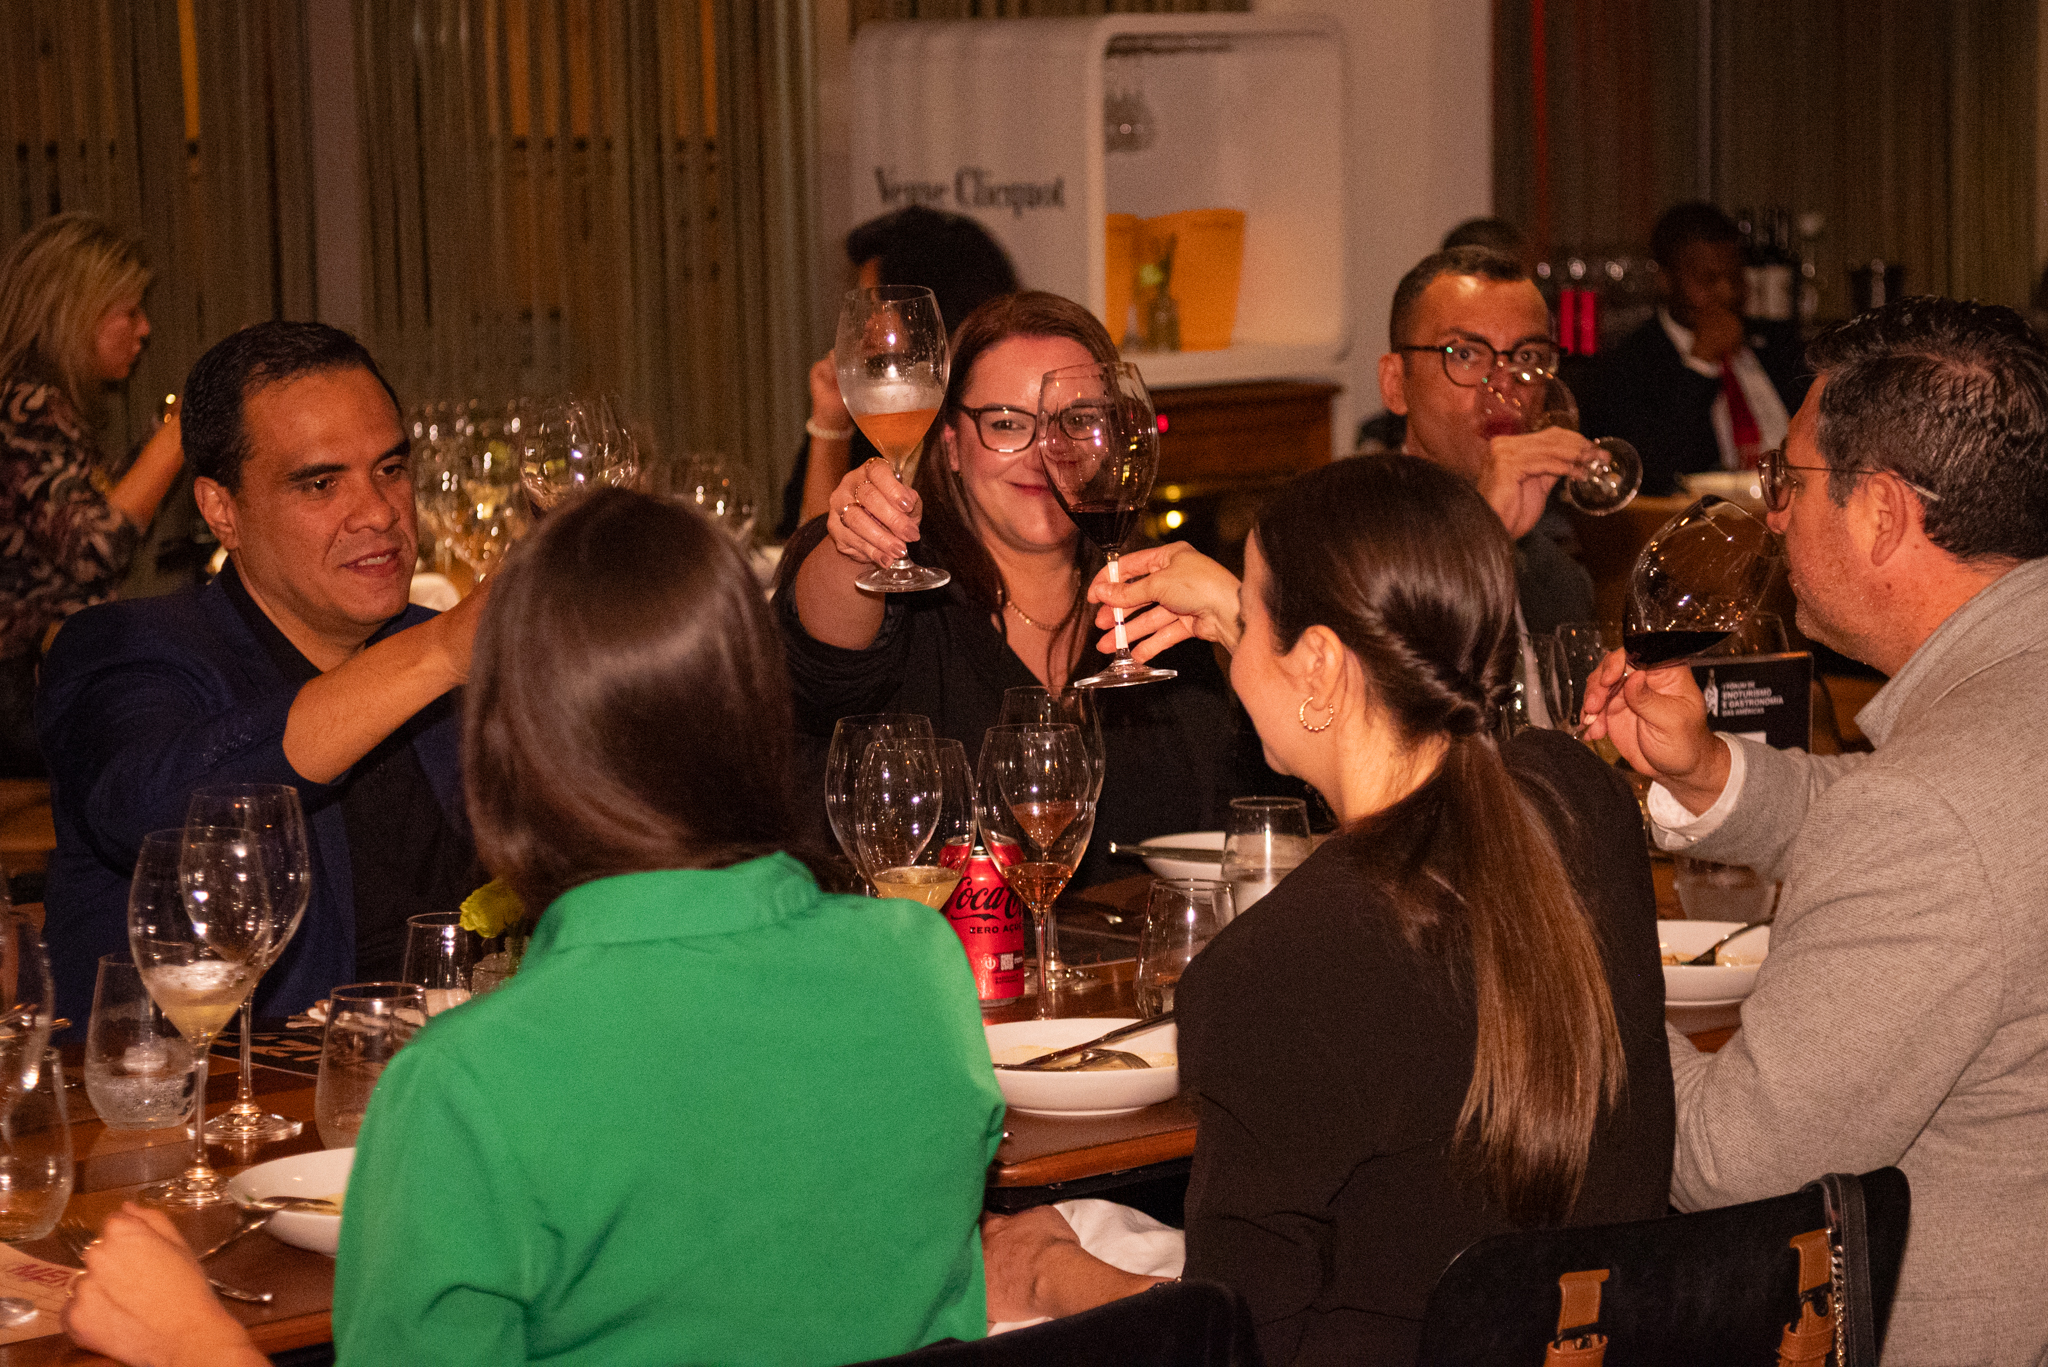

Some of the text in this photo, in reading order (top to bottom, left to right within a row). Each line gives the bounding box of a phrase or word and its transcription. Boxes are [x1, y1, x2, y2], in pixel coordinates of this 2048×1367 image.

[1722, 687, 1772, 700] ENOTURISMO
[1722, 695, 1784, 709] E GASTRONOMIA
[969, 926, 999, 934] ZERO
